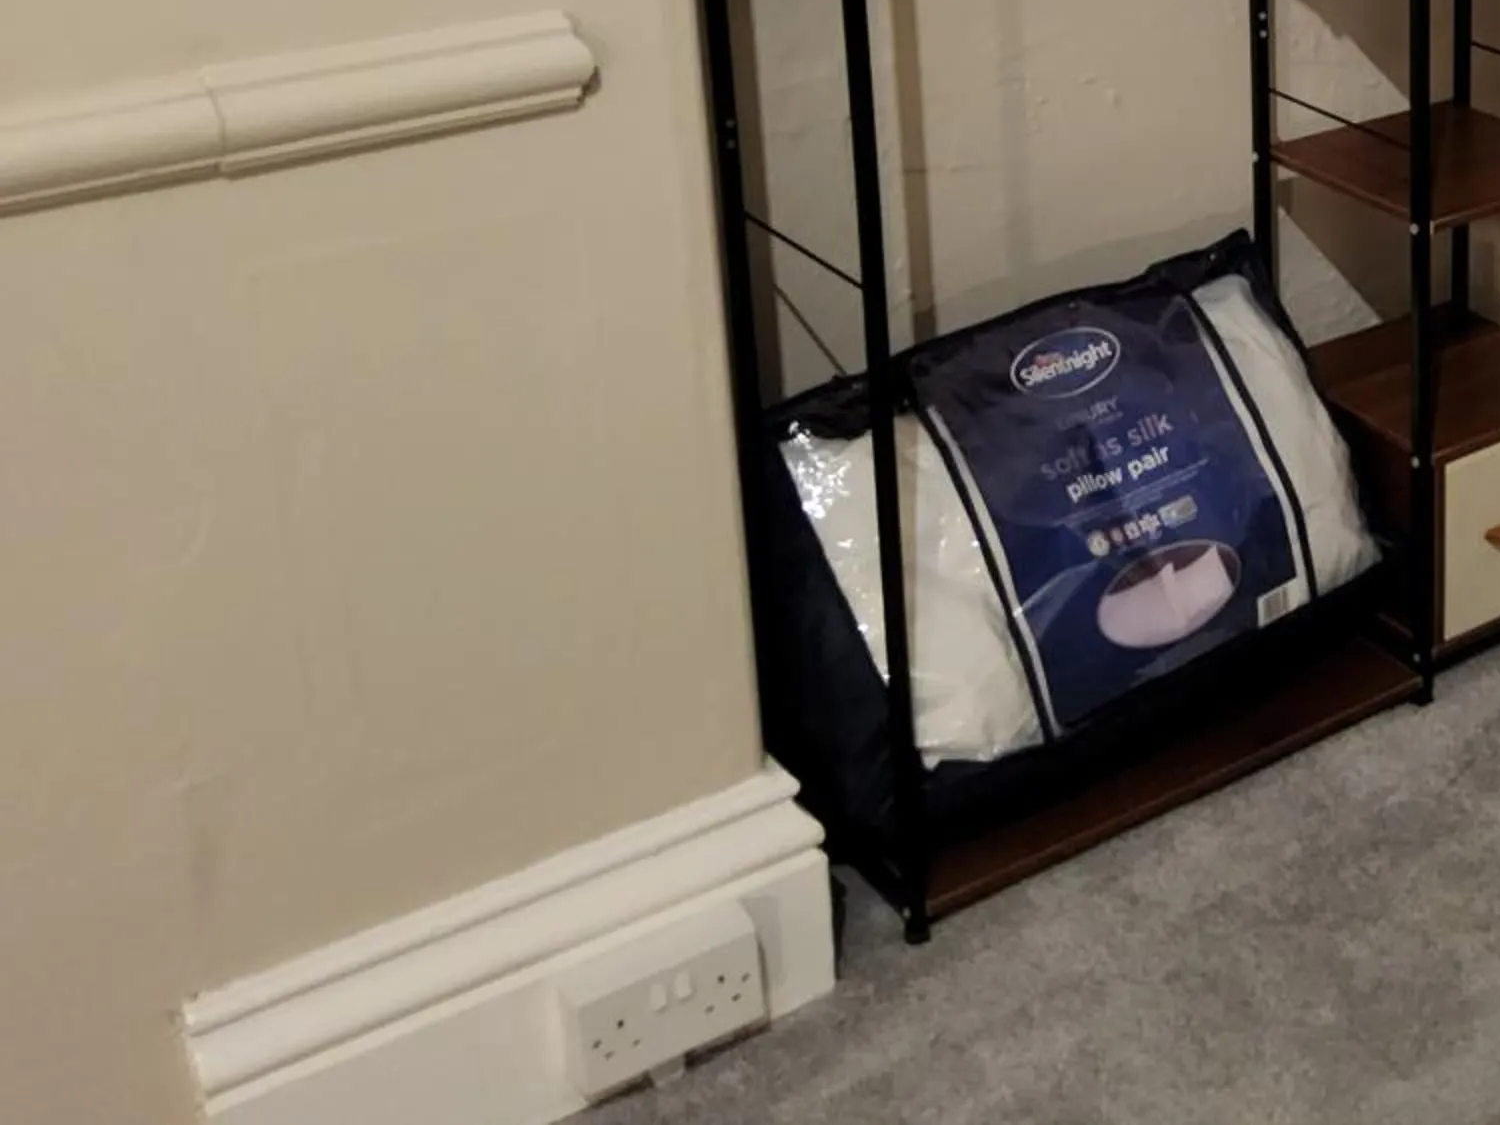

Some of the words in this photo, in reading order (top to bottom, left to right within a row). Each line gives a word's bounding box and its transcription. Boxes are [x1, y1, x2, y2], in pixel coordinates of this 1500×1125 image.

[1020, 341, 1113, 387] Silentnight
[1127, 414, 1174, 447] silk
[1066, 466, 1123, 504] pillow
[1127, 446, 1170, 480] pair
